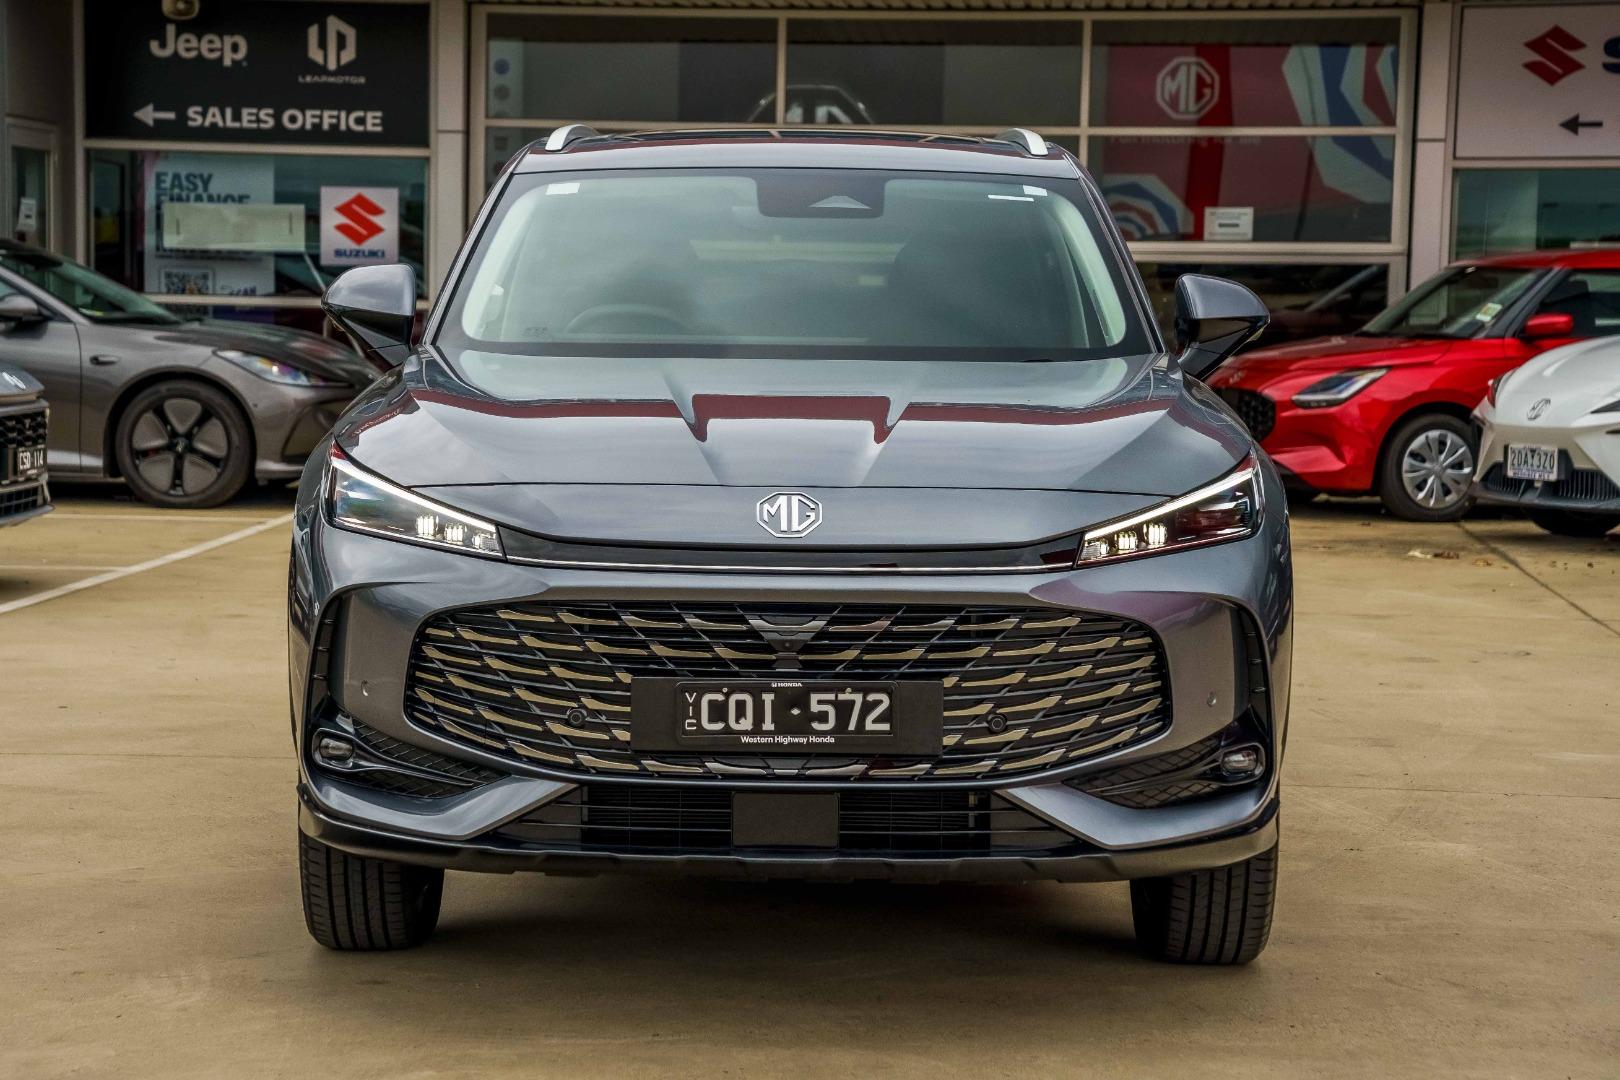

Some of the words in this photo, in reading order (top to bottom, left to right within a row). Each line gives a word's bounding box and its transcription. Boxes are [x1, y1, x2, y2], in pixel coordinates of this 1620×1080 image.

[150, 23, 248, 67] Jeep
[1160, 60, 1214, 116] MG
[187, 105, 275, 129] SALES
[282, 108, 383, 132] OFFICE
[155, 171, 213, 192] EASY
[334, 248, 386, 259] SUZUKI
[762, 495, 816, 532] MG
[685, 692, 697, 730] VIC
[701, 692, 775, 731] CQI
[810, 692, 891, 731] 572
[740, 735, 773, 744] Western
[774, 735, 808, 745] Highway
[809, 735, 835, 744] Honda
